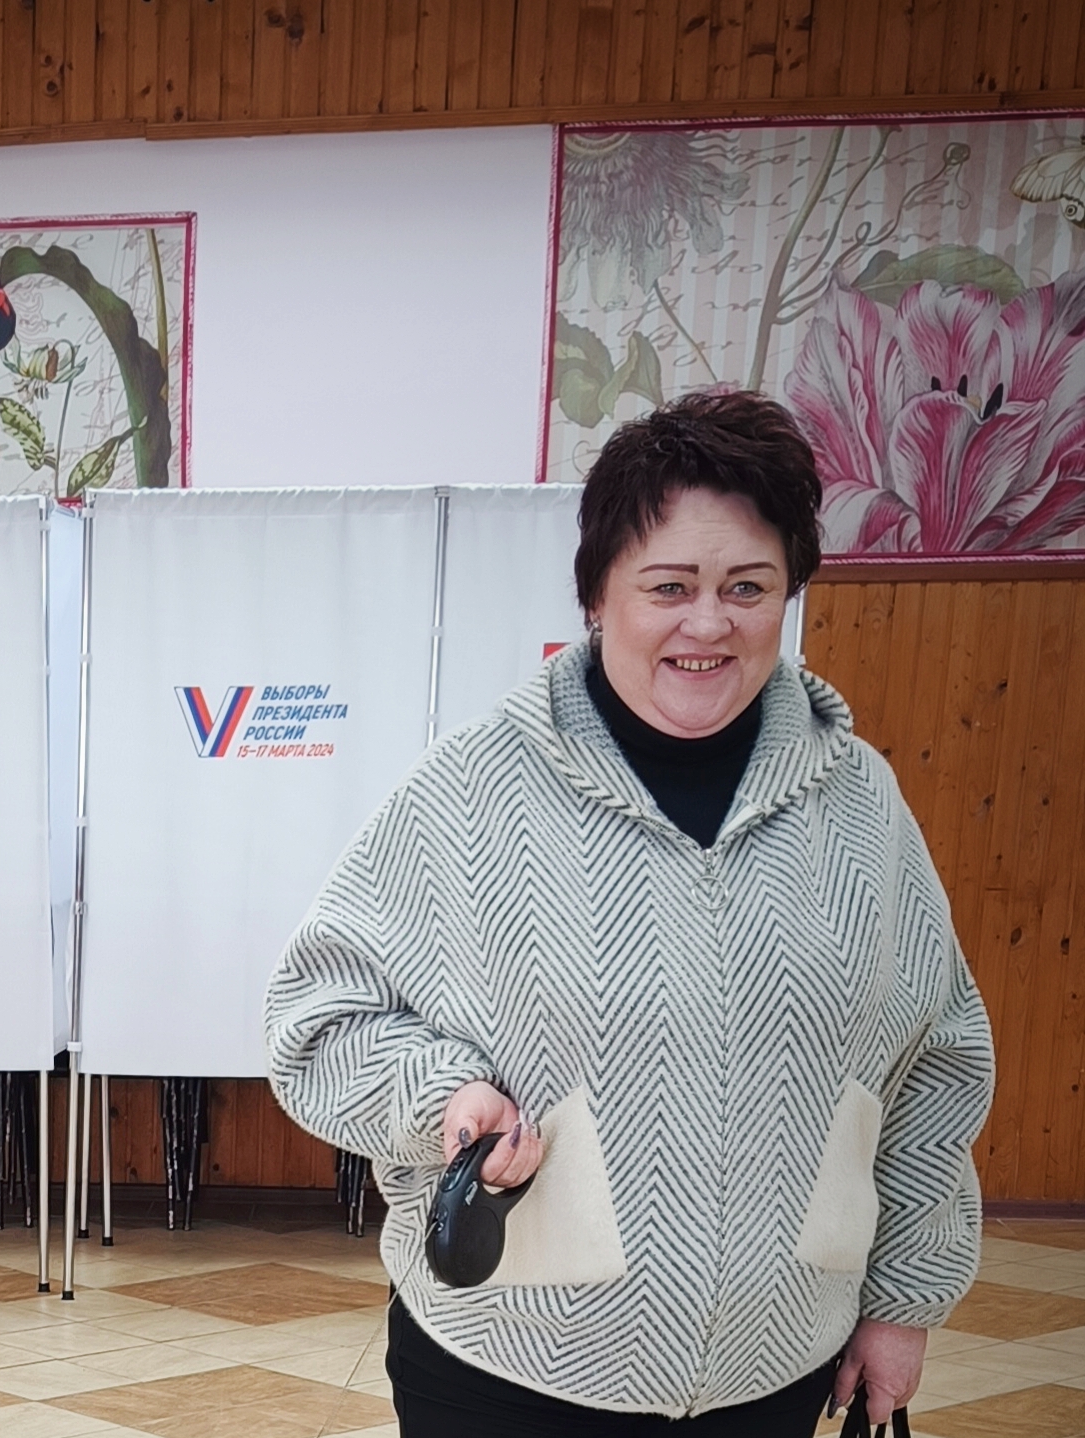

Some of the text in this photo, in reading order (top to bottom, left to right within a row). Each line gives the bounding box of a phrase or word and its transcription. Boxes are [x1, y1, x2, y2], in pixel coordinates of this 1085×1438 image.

[261, 684, 331, 700] ВЫБОРЫ
[252, 704, 349, 721] ПРЕЗИДЕНТА
[243, 725, 307, 740] РОССИИ
[268, 744, 306, 757] МАРТА
[307, 743, 334, 757] 2024
